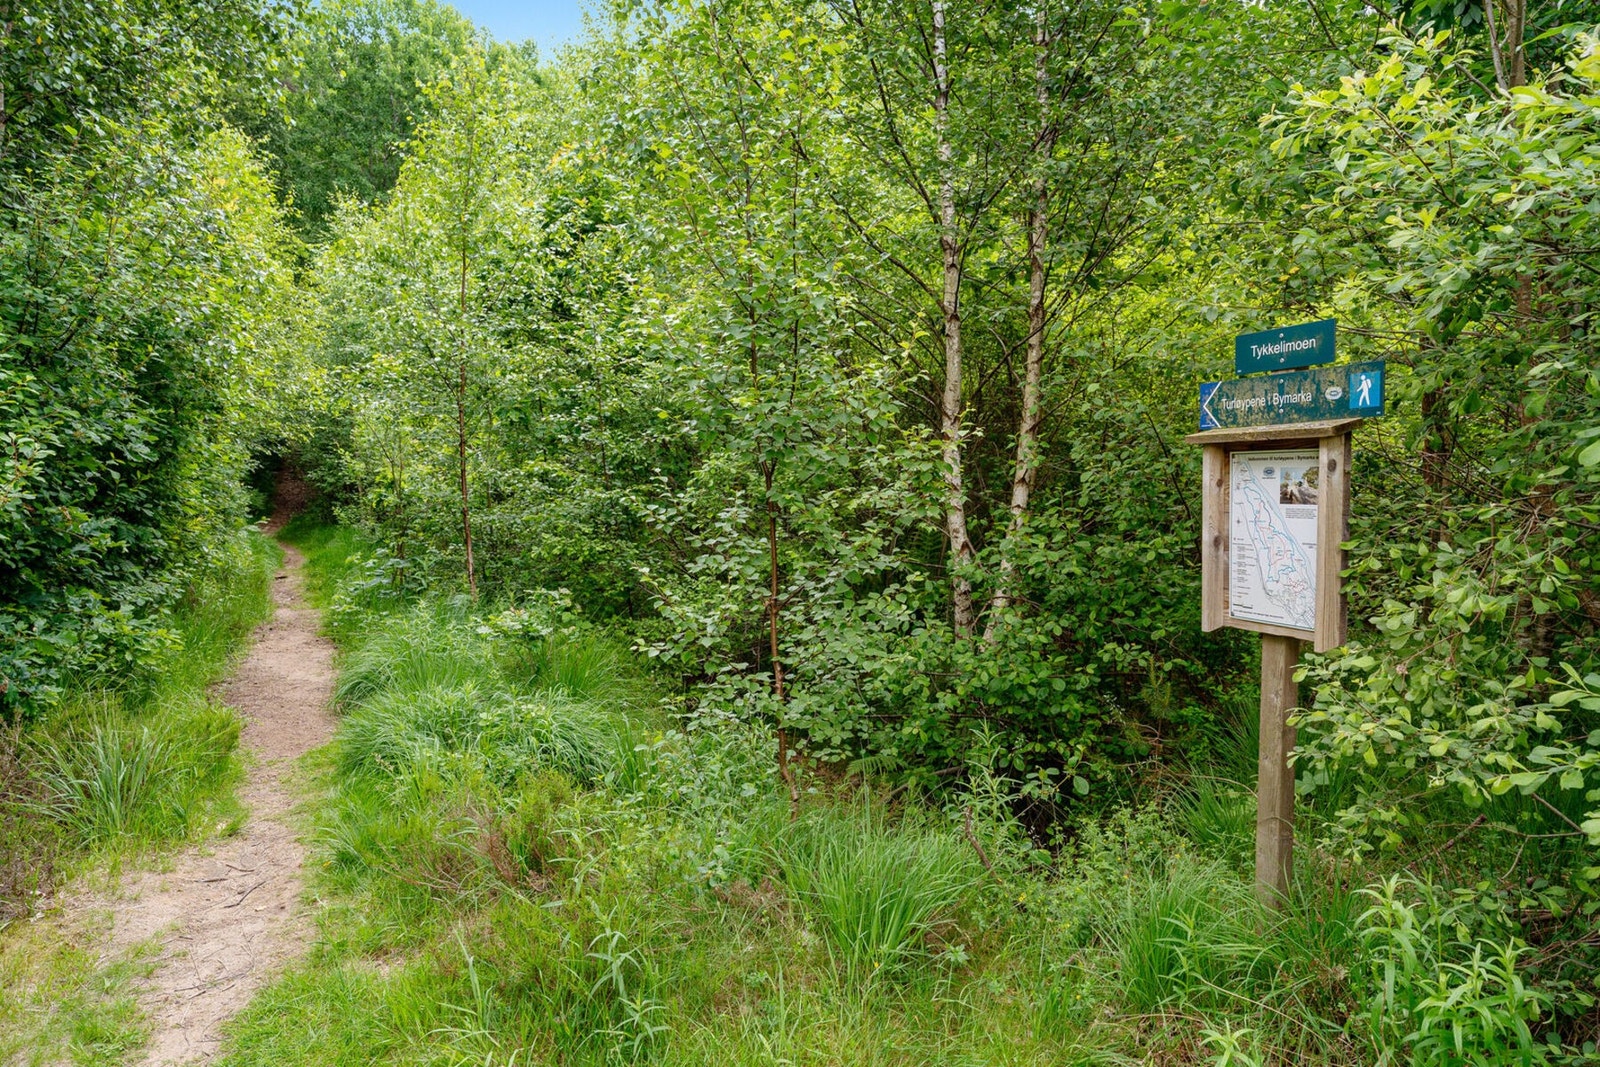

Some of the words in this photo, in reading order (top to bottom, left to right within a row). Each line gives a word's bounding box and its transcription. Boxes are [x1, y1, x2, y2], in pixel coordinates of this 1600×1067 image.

[1251, 337, 1316, 360] Tykkelimoen
[1221, 397, 1266, 411] Turløypene
[1267, 393, 1271, 405] i
[1273, 391, 1312, 408] Bymarka
